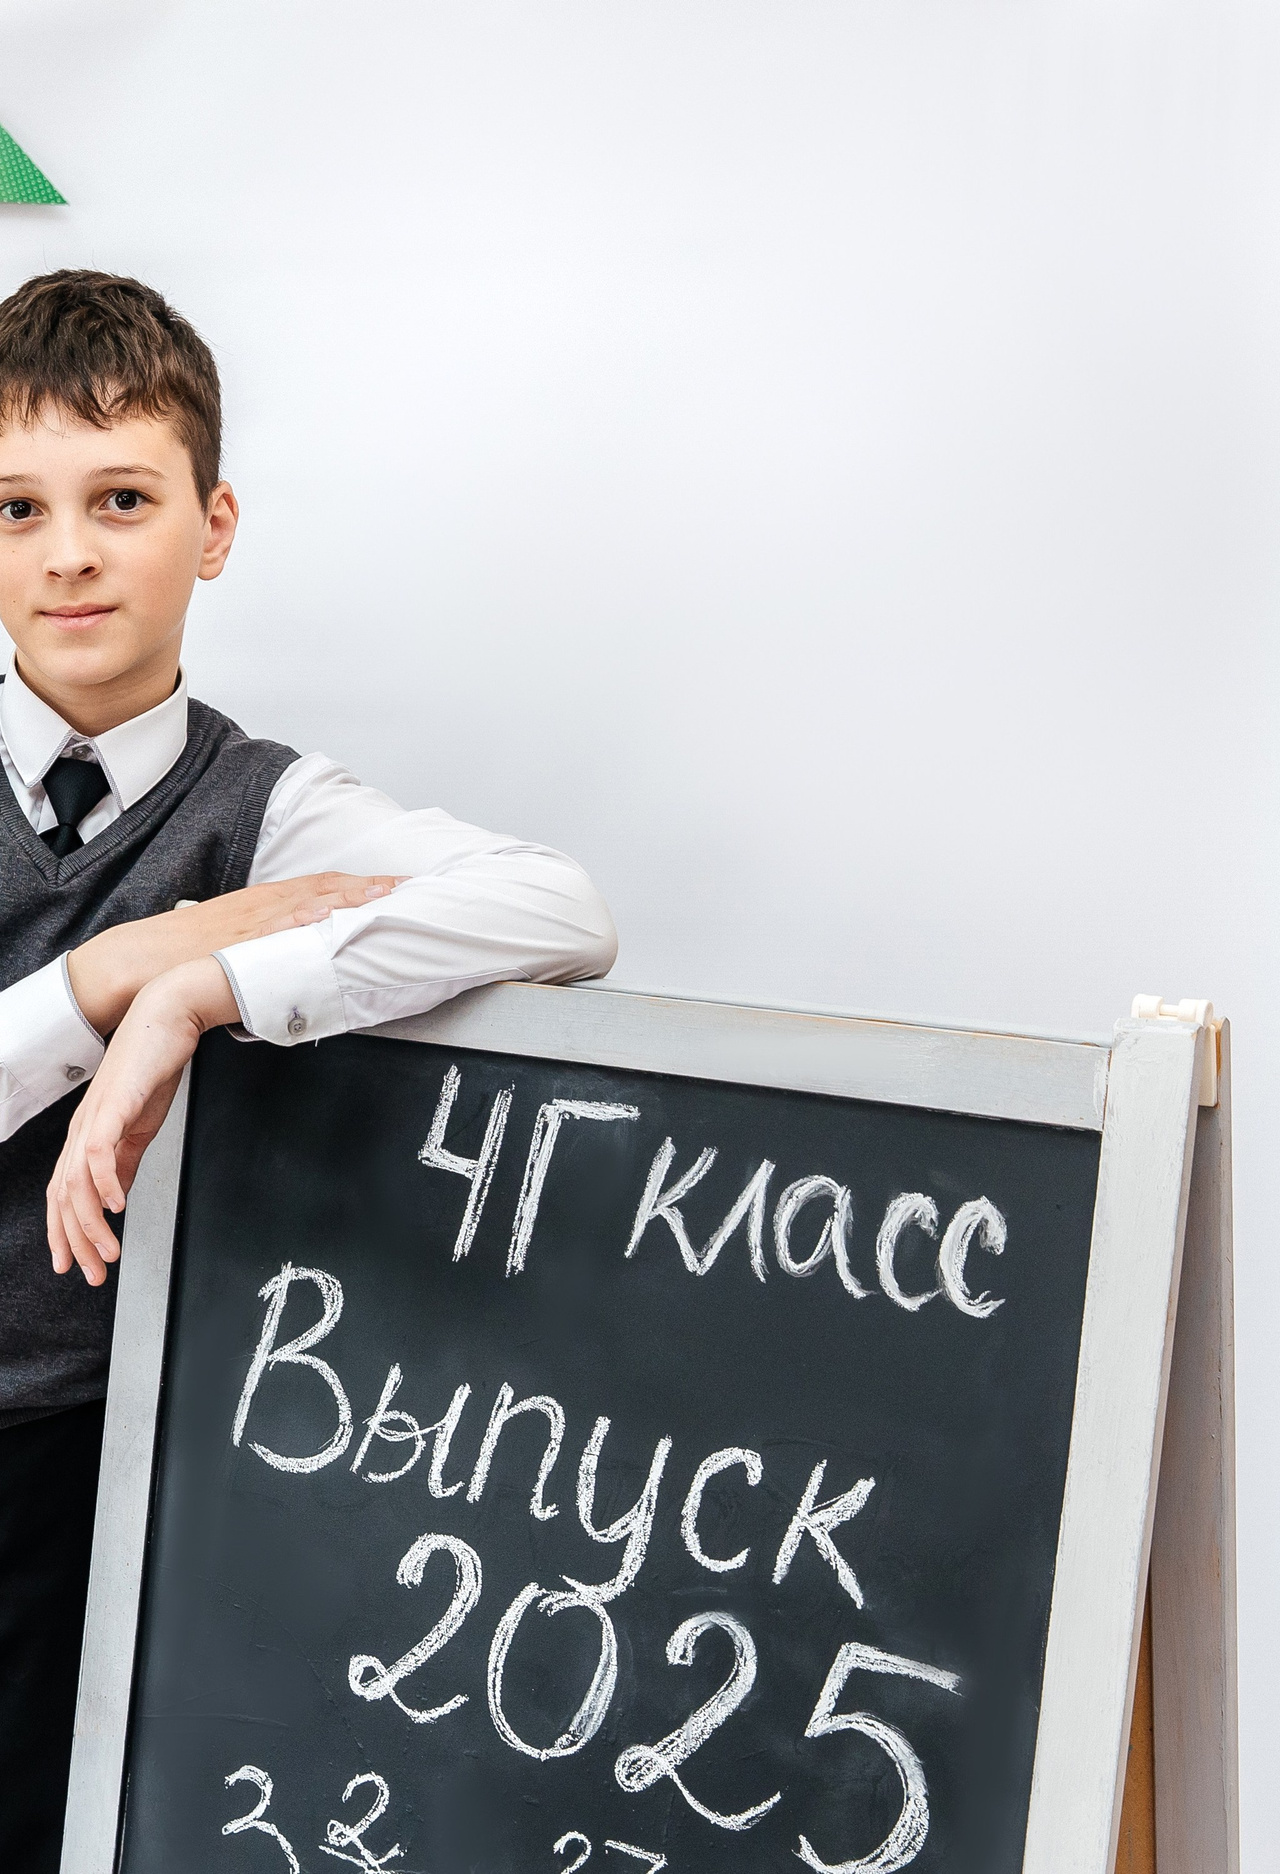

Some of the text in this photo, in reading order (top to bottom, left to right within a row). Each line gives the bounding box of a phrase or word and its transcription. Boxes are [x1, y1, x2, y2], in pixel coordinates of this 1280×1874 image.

[623, 1135, 1008, 1320] класс
[230, 1260, 877, 1611] Выпуск
[346, 1530, 964, 1874] 2025
